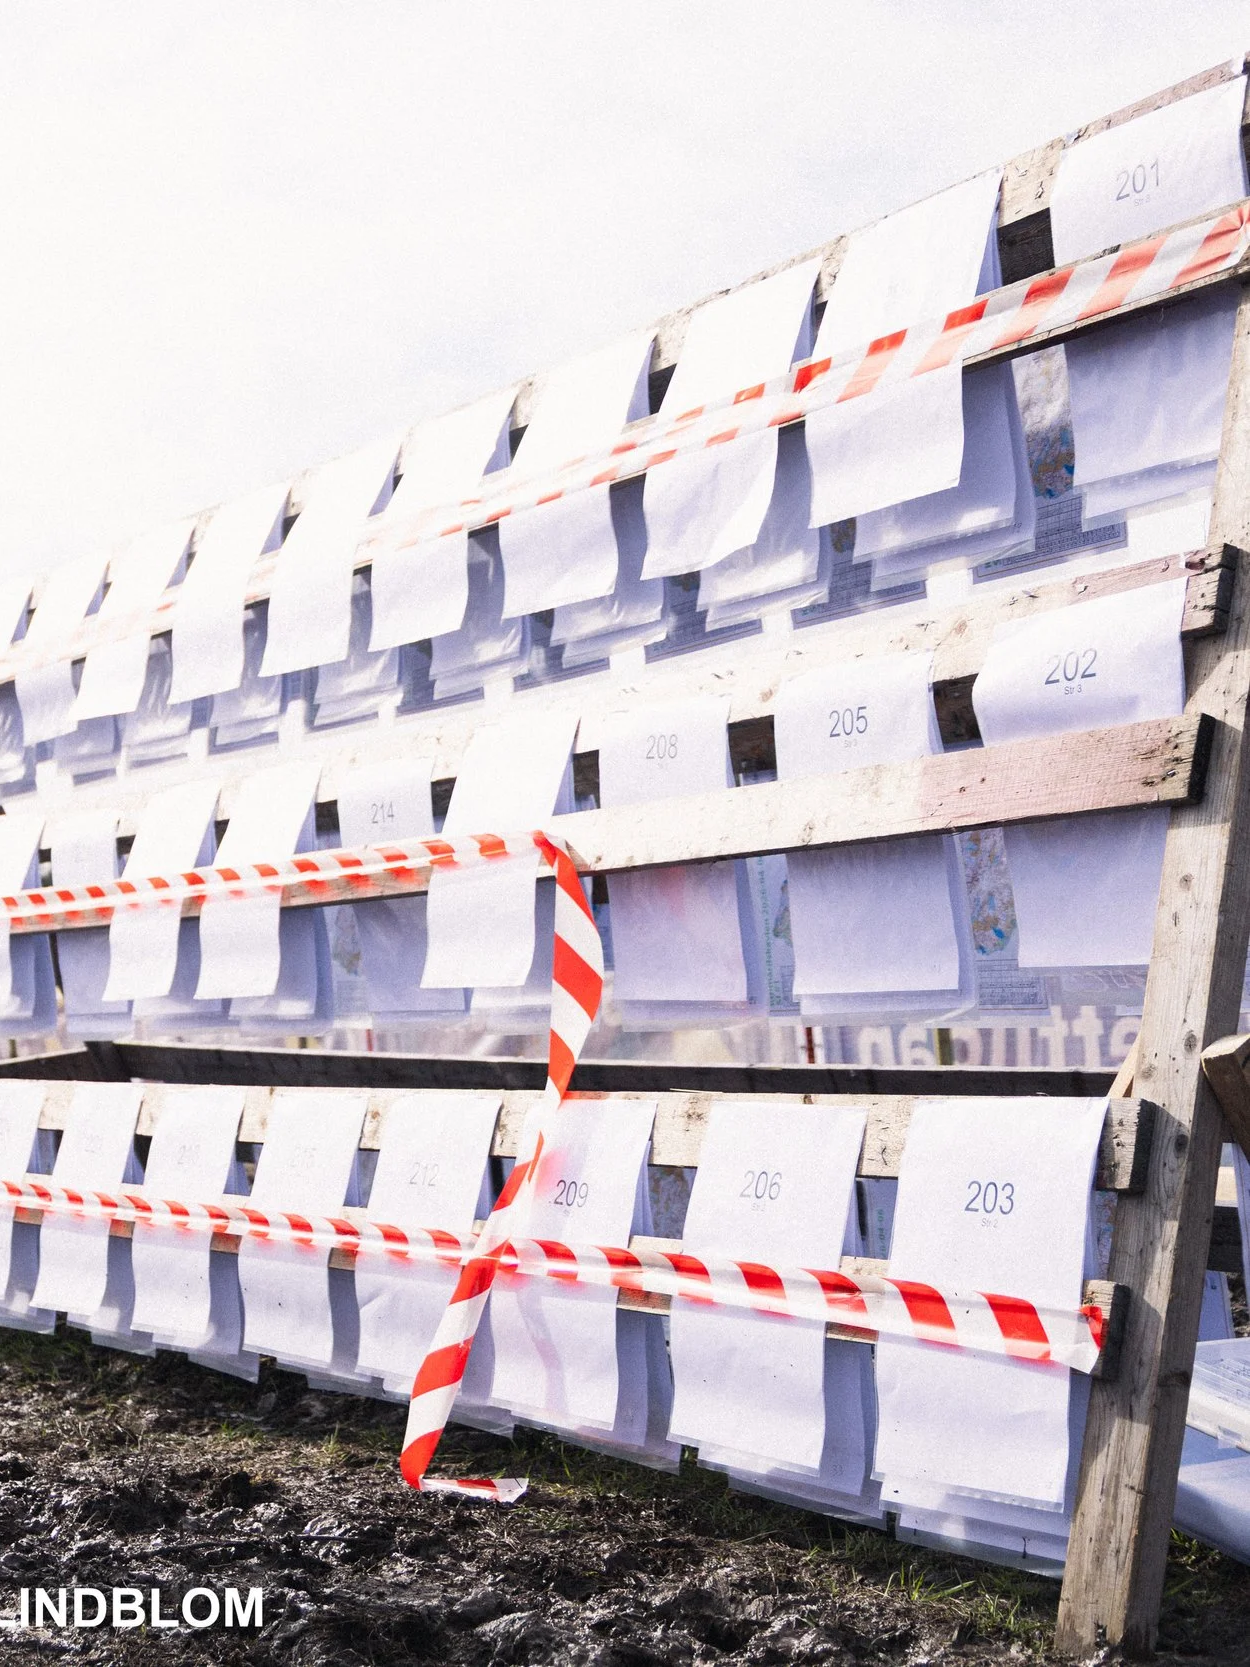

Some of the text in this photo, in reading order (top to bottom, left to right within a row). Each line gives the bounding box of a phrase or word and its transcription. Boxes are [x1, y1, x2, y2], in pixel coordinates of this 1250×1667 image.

[1116, 159, 1160, 201] 201
[1044, 648, 1097, 685] 202
[829, 706, 868, 737] 205
[646, 734, 678, 760] 208
[371, 803, 395, 825] 214
[409, 1162, 440, 1188] 212
[739, 1170, 783, 1201] 206
[554, 1179, 589, 1208] 209
[964, 1180, 1015, 1216] 203
